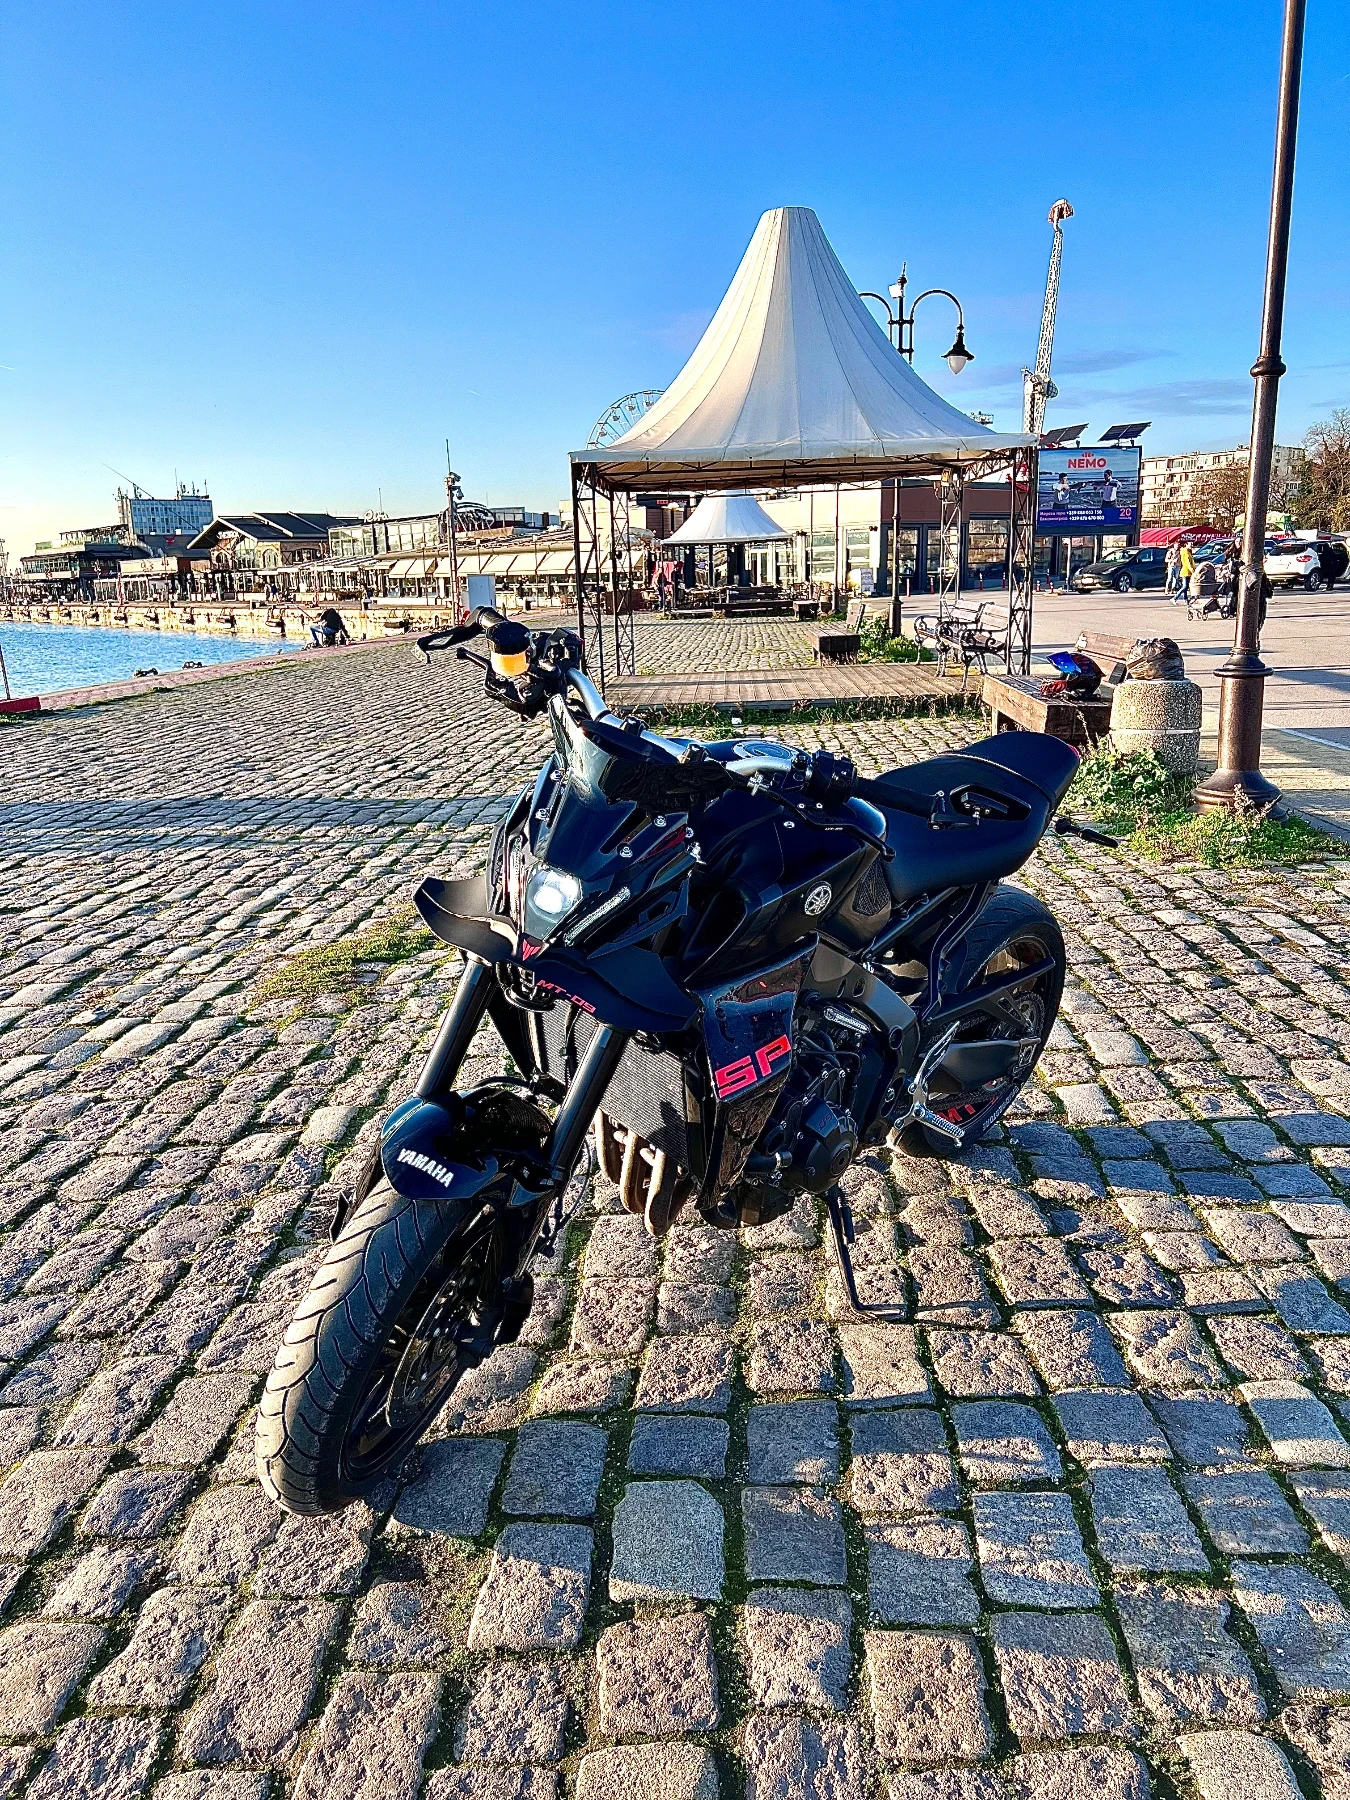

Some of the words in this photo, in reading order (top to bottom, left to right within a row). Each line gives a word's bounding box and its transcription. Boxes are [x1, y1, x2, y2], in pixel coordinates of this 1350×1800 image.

[1067, 458, 1107, 468] NEMO
[536, 979, 596, 1014] MT-09
[715, 1034, 792, 1099] SP
[396, 1147, 455, 1188] YAMAHA
